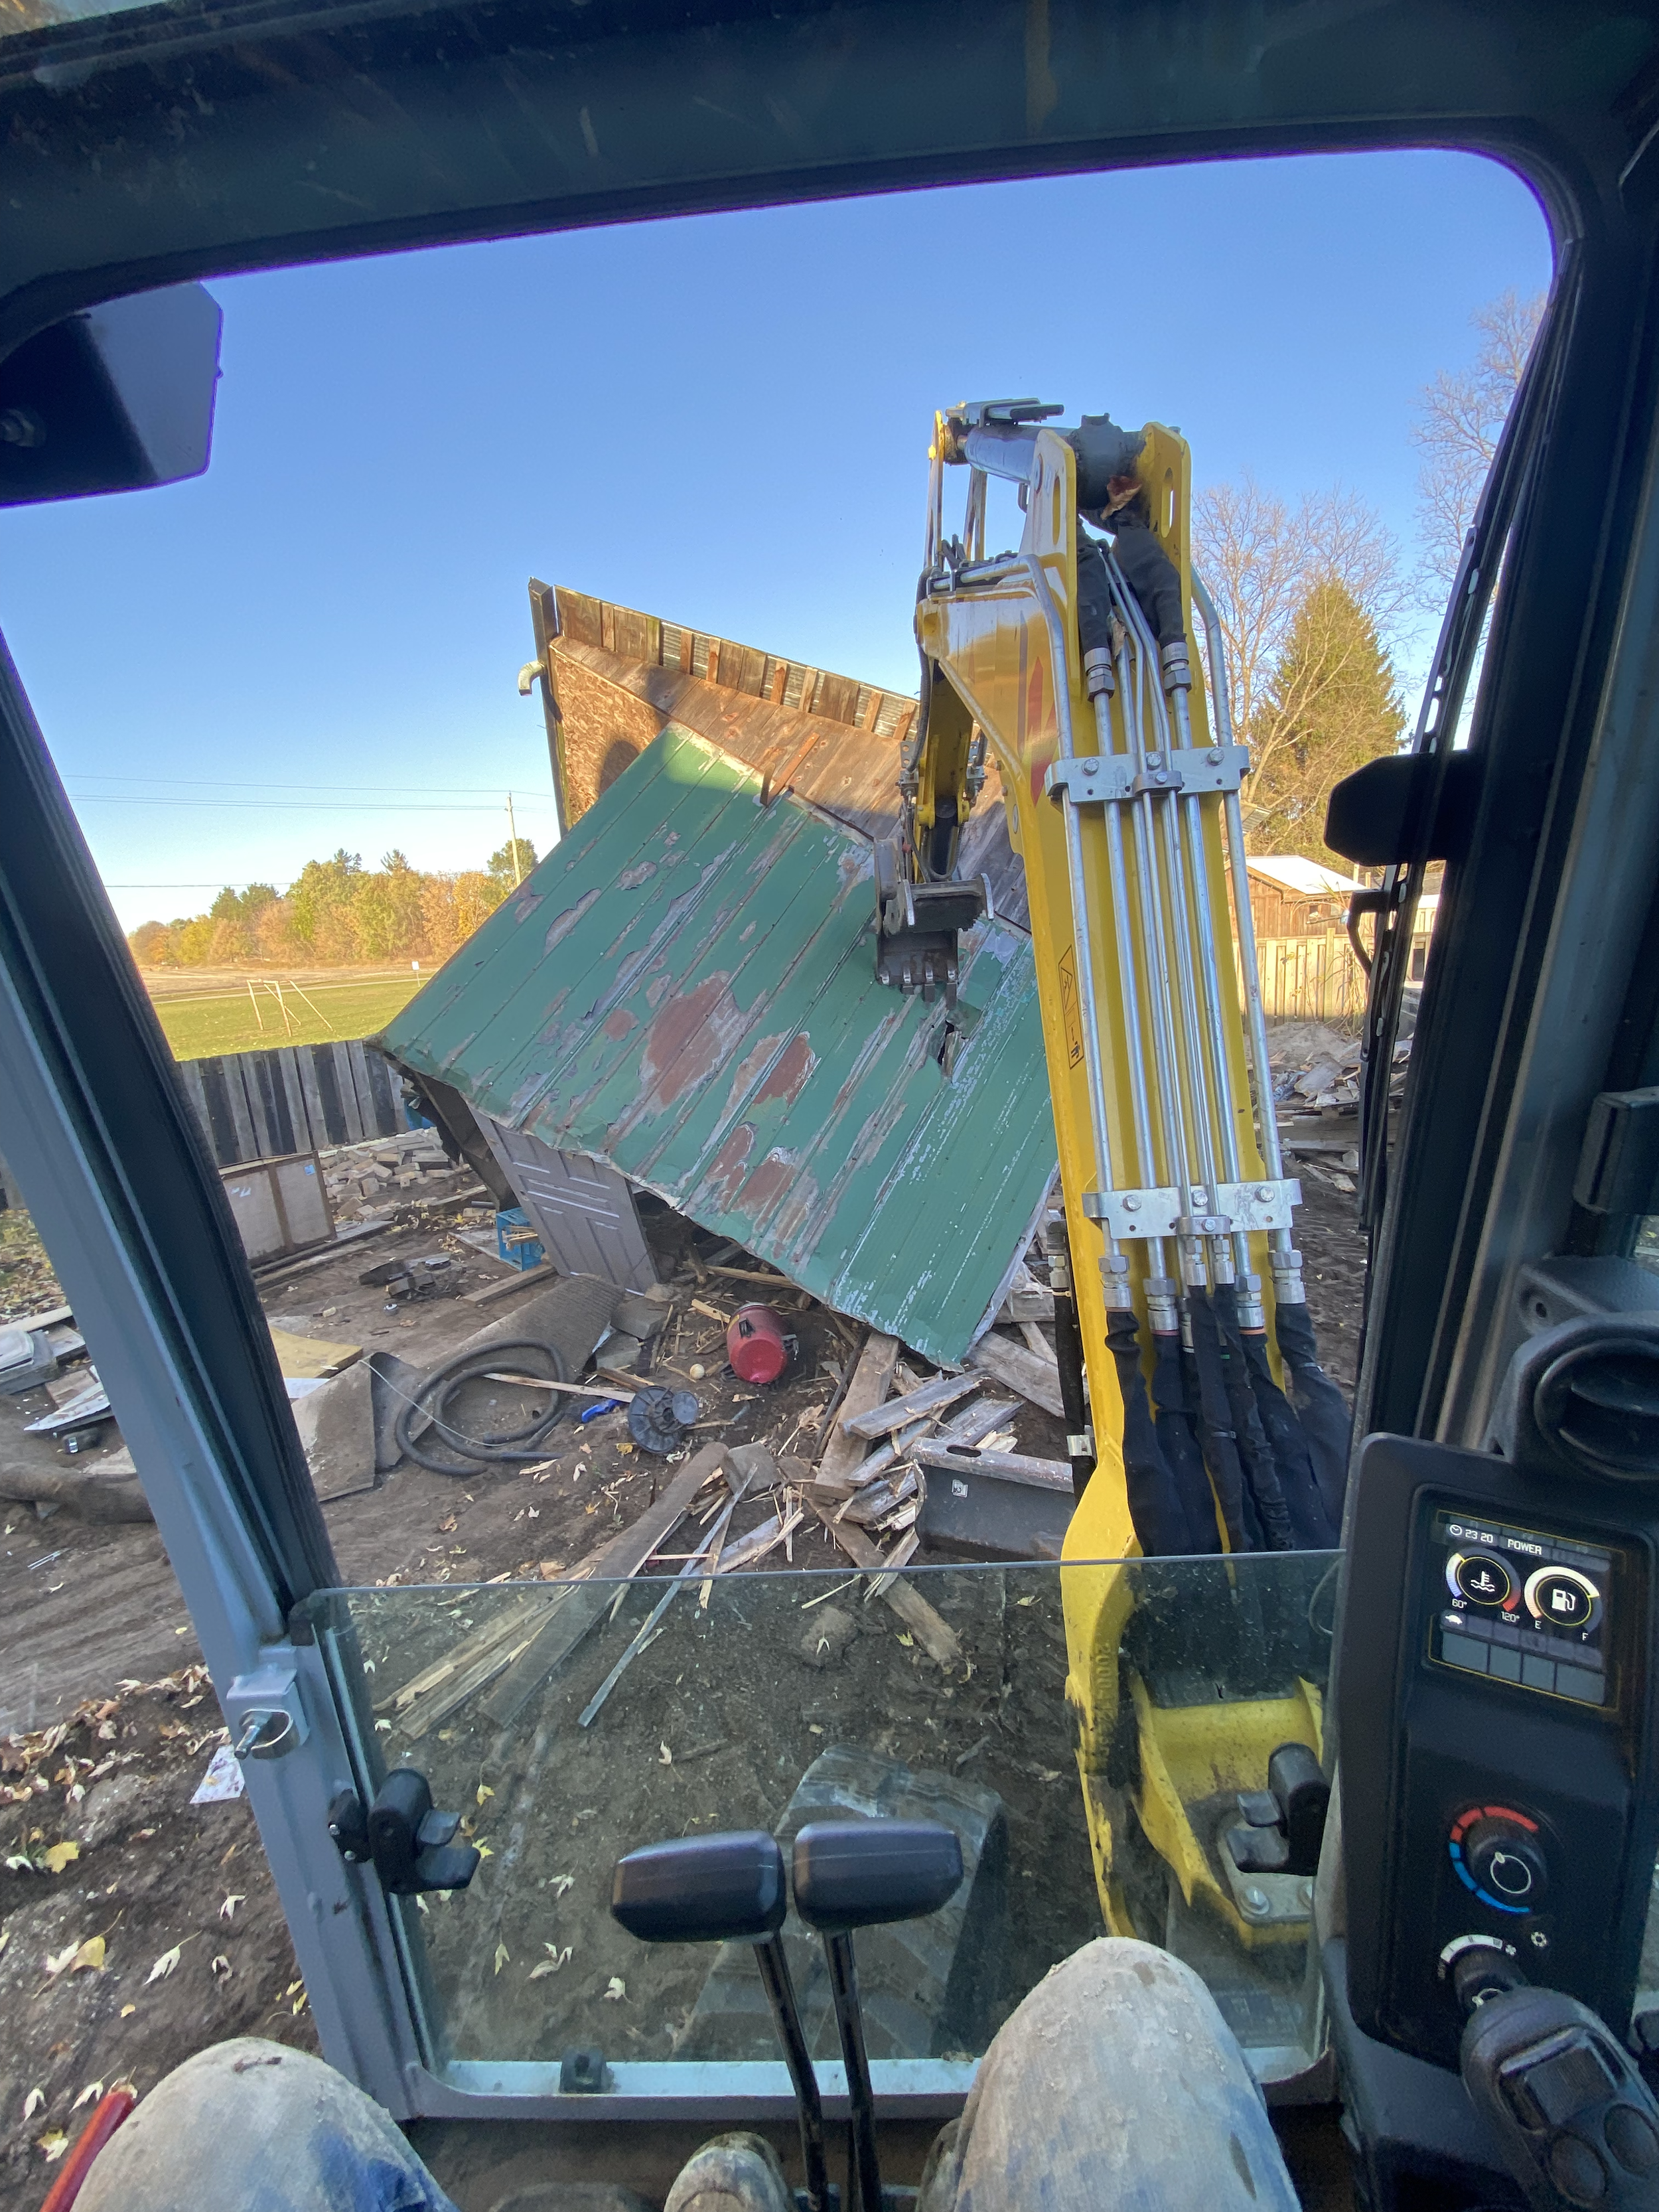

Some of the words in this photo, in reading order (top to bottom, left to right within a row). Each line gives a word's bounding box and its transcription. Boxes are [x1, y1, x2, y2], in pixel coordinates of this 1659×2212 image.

[1508, 1538, 1542, 1555] POWER
[1534, 1620, 1542, 1629] E
[1581, 1632, 1589, 1641] F
